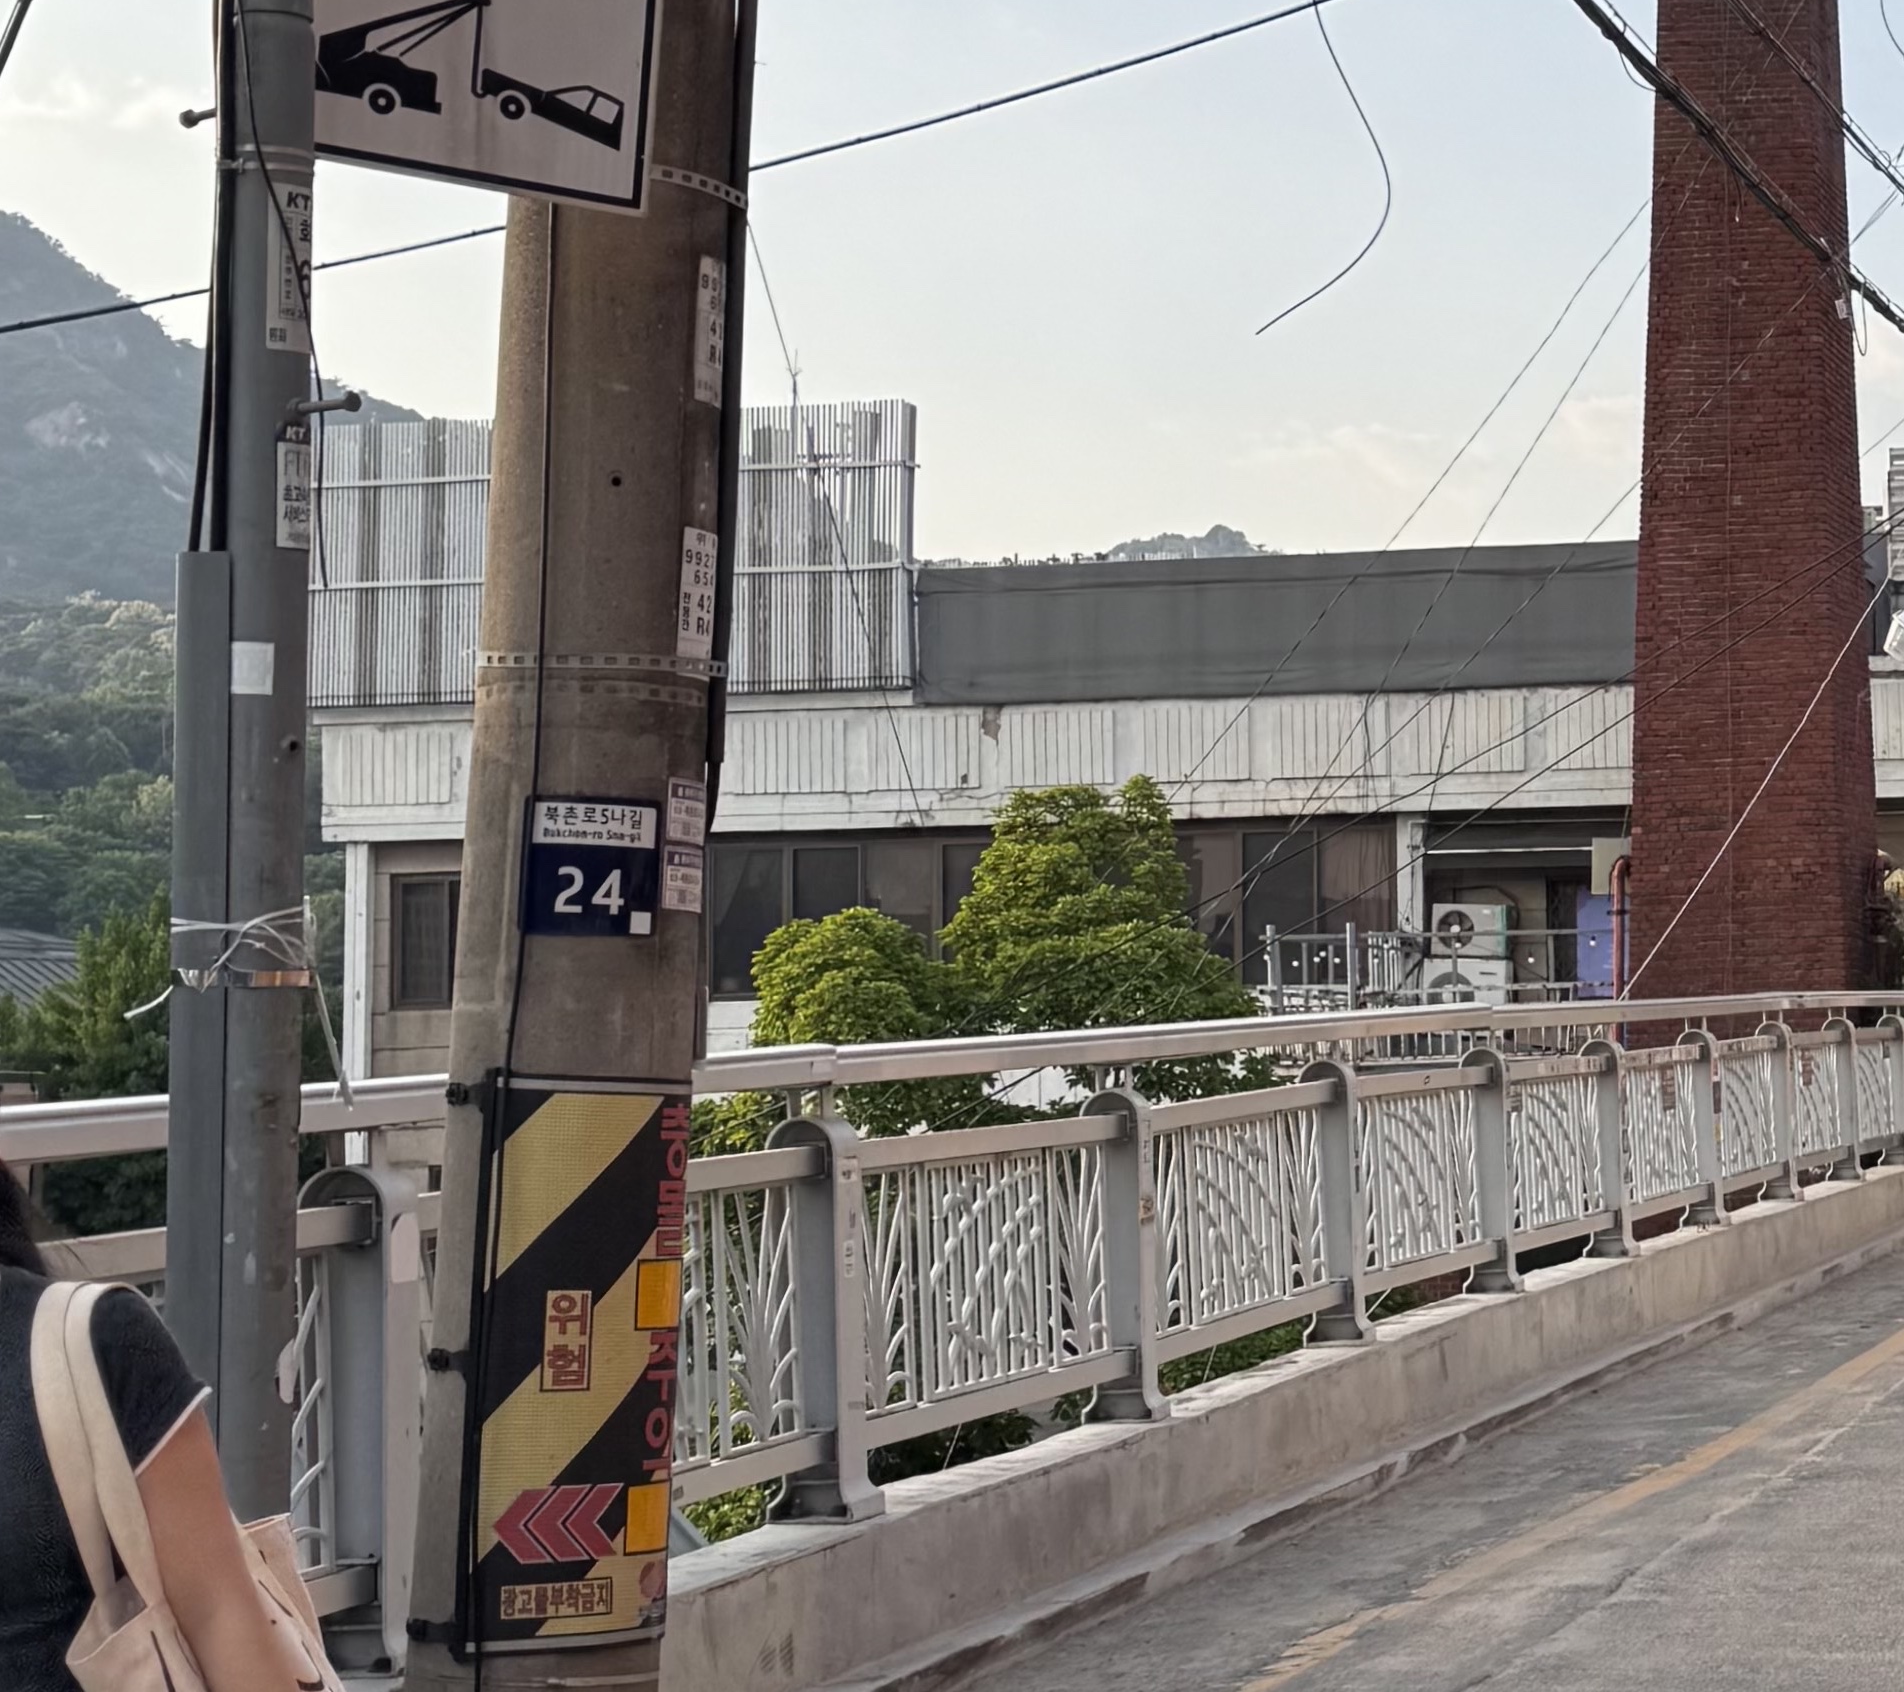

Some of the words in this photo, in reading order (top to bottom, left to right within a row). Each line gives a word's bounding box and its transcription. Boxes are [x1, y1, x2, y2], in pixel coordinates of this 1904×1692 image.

[286, 191, 310, 211] KT
[286, 425, 307, 441] KT
[544, 805, 643, 830] 북촌로5나길
[553, 865, 625, 915] 24
[546, 1292, 589, 1388] 위험
[502, 1578, 609, 1617] 광고물부착금지
